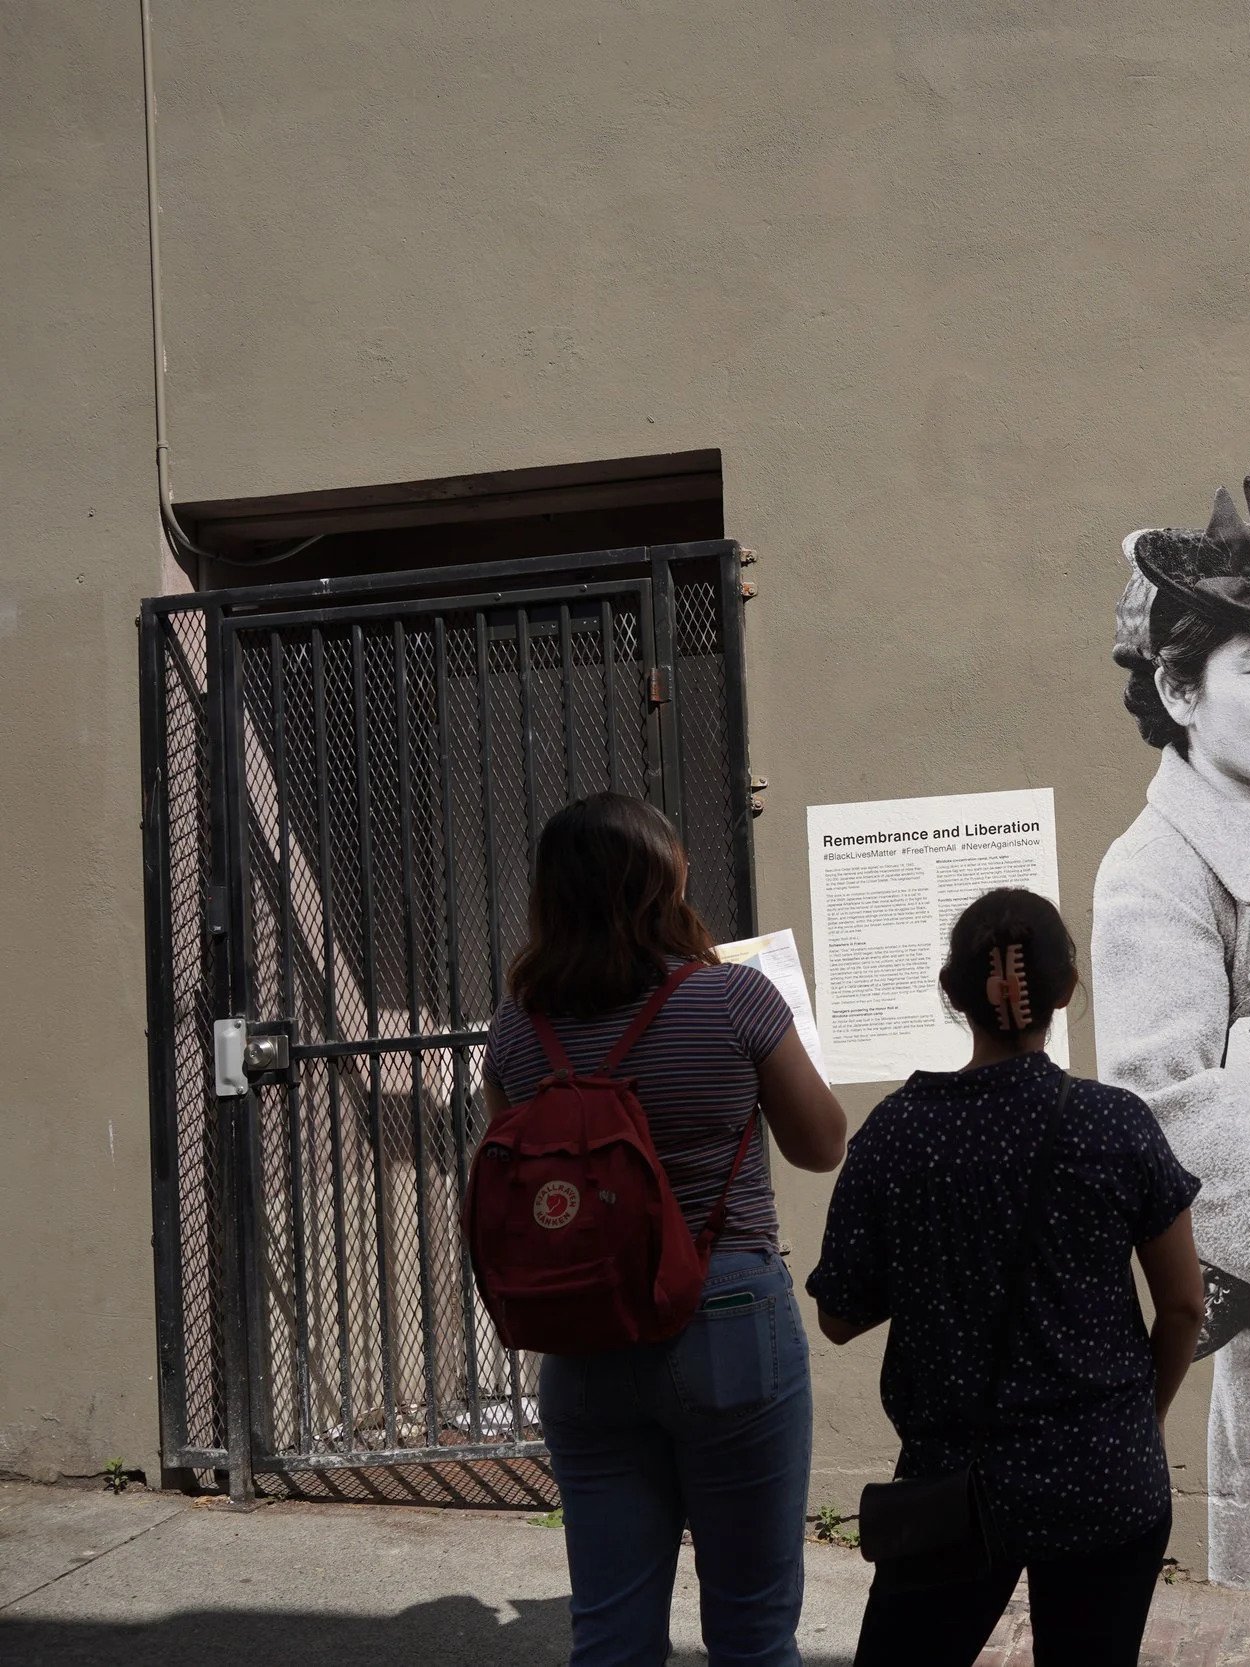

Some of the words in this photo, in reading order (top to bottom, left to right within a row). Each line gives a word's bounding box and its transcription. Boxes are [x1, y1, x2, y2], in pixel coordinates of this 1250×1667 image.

[823, 829, 928, 848] Remembrance
[933, 825, 960, 839] and
[965, 820, 1040, 837] Liberation
[823, 848, 897, 861] #BlackLivesMatter
[901, 844, 957, 855] #FreeThemAll
[961, 838, 1041, 852] #NeverAgainIsNow
